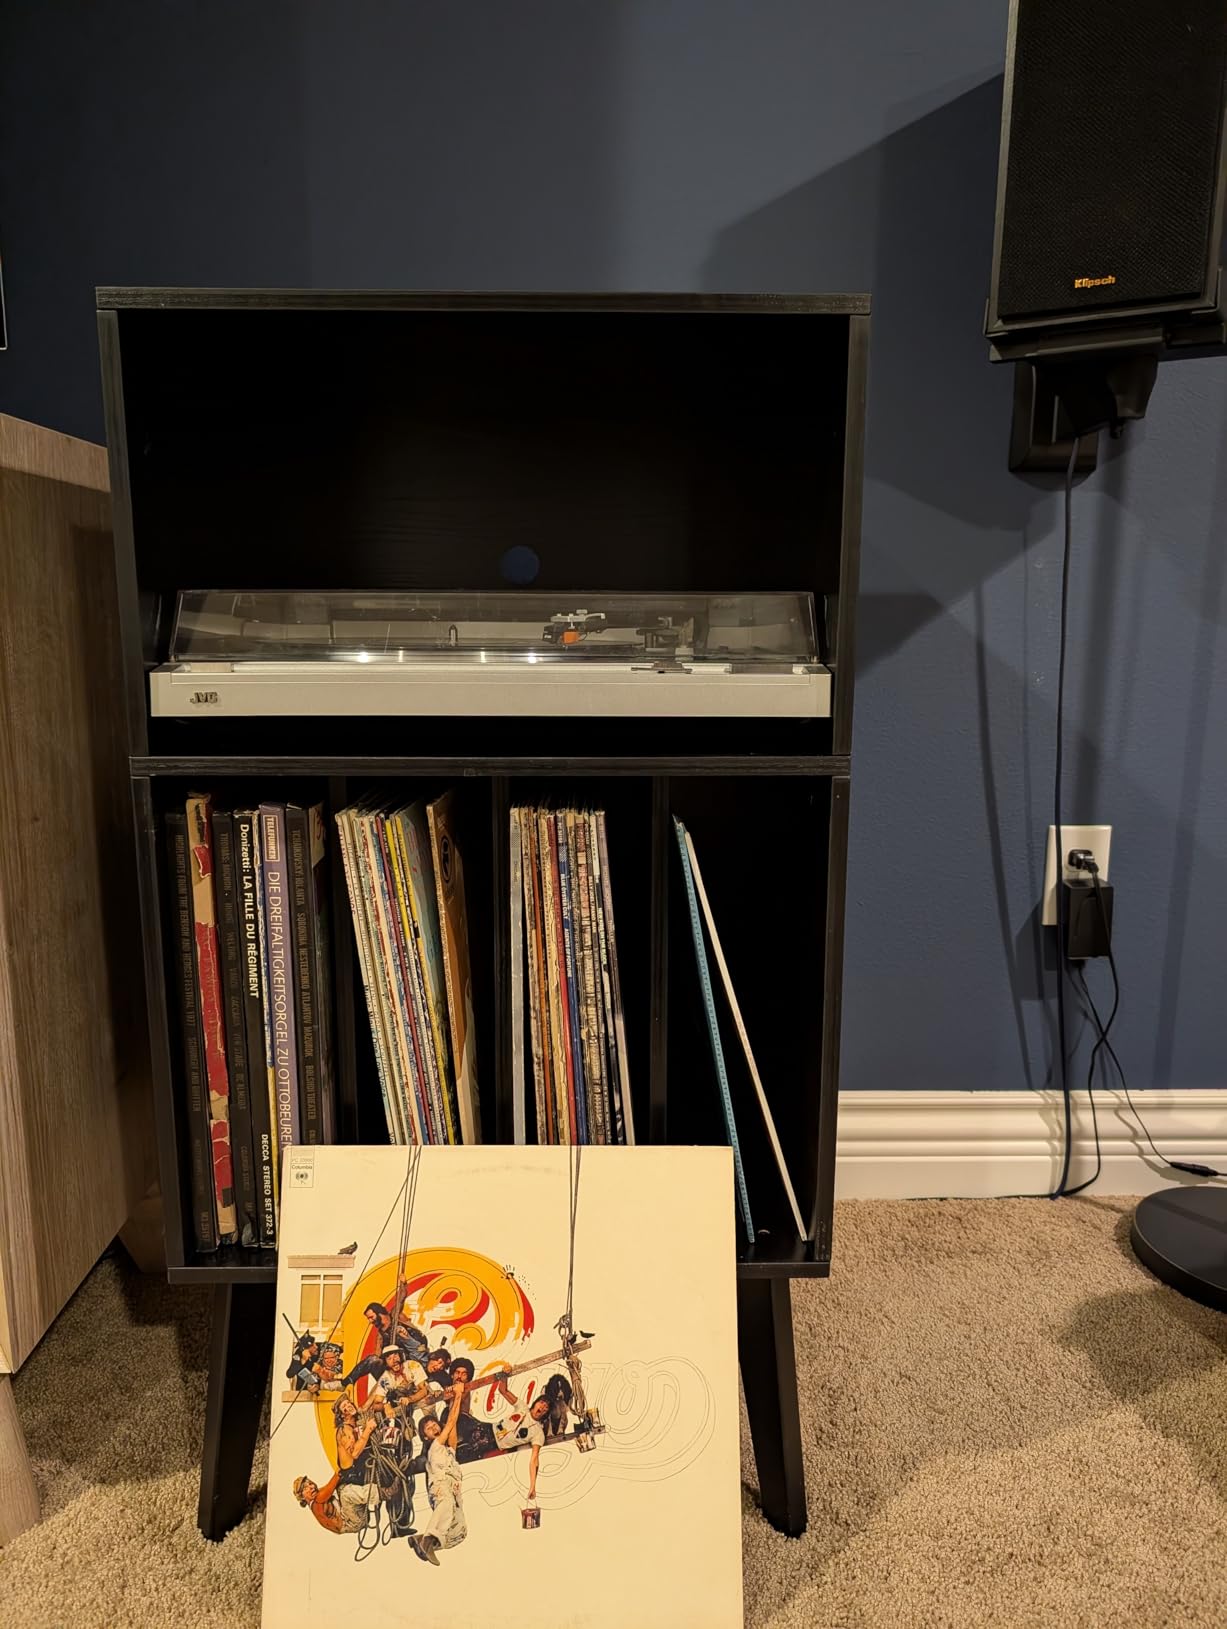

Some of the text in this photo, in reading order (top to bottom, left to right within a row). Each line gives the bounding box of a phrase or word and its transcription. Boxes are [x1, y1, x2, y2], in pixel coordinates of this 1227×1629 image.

[1074, 275, 1116, 289] Klipsch
[190, 691, 218, 704] JVC
[240, 824, 253, 872] Donizetti:
[266, 817, 277, 859] TELEFUNKEN
[242, 875, 254, 889] LA
[269, 872, 281, 892] DIE
[243, 892, 255, 919] FILLE
[244, 923, 256, 938] DU
[270, 896, 288, 1044] DREIFALTIGKEITSORGEL
[565, 956, 573, 977] FORTUNE
[277, 1048, 289, 1065] ZU
[260, 1134, 274, 1235] DECCA STEREO SET 372-3
